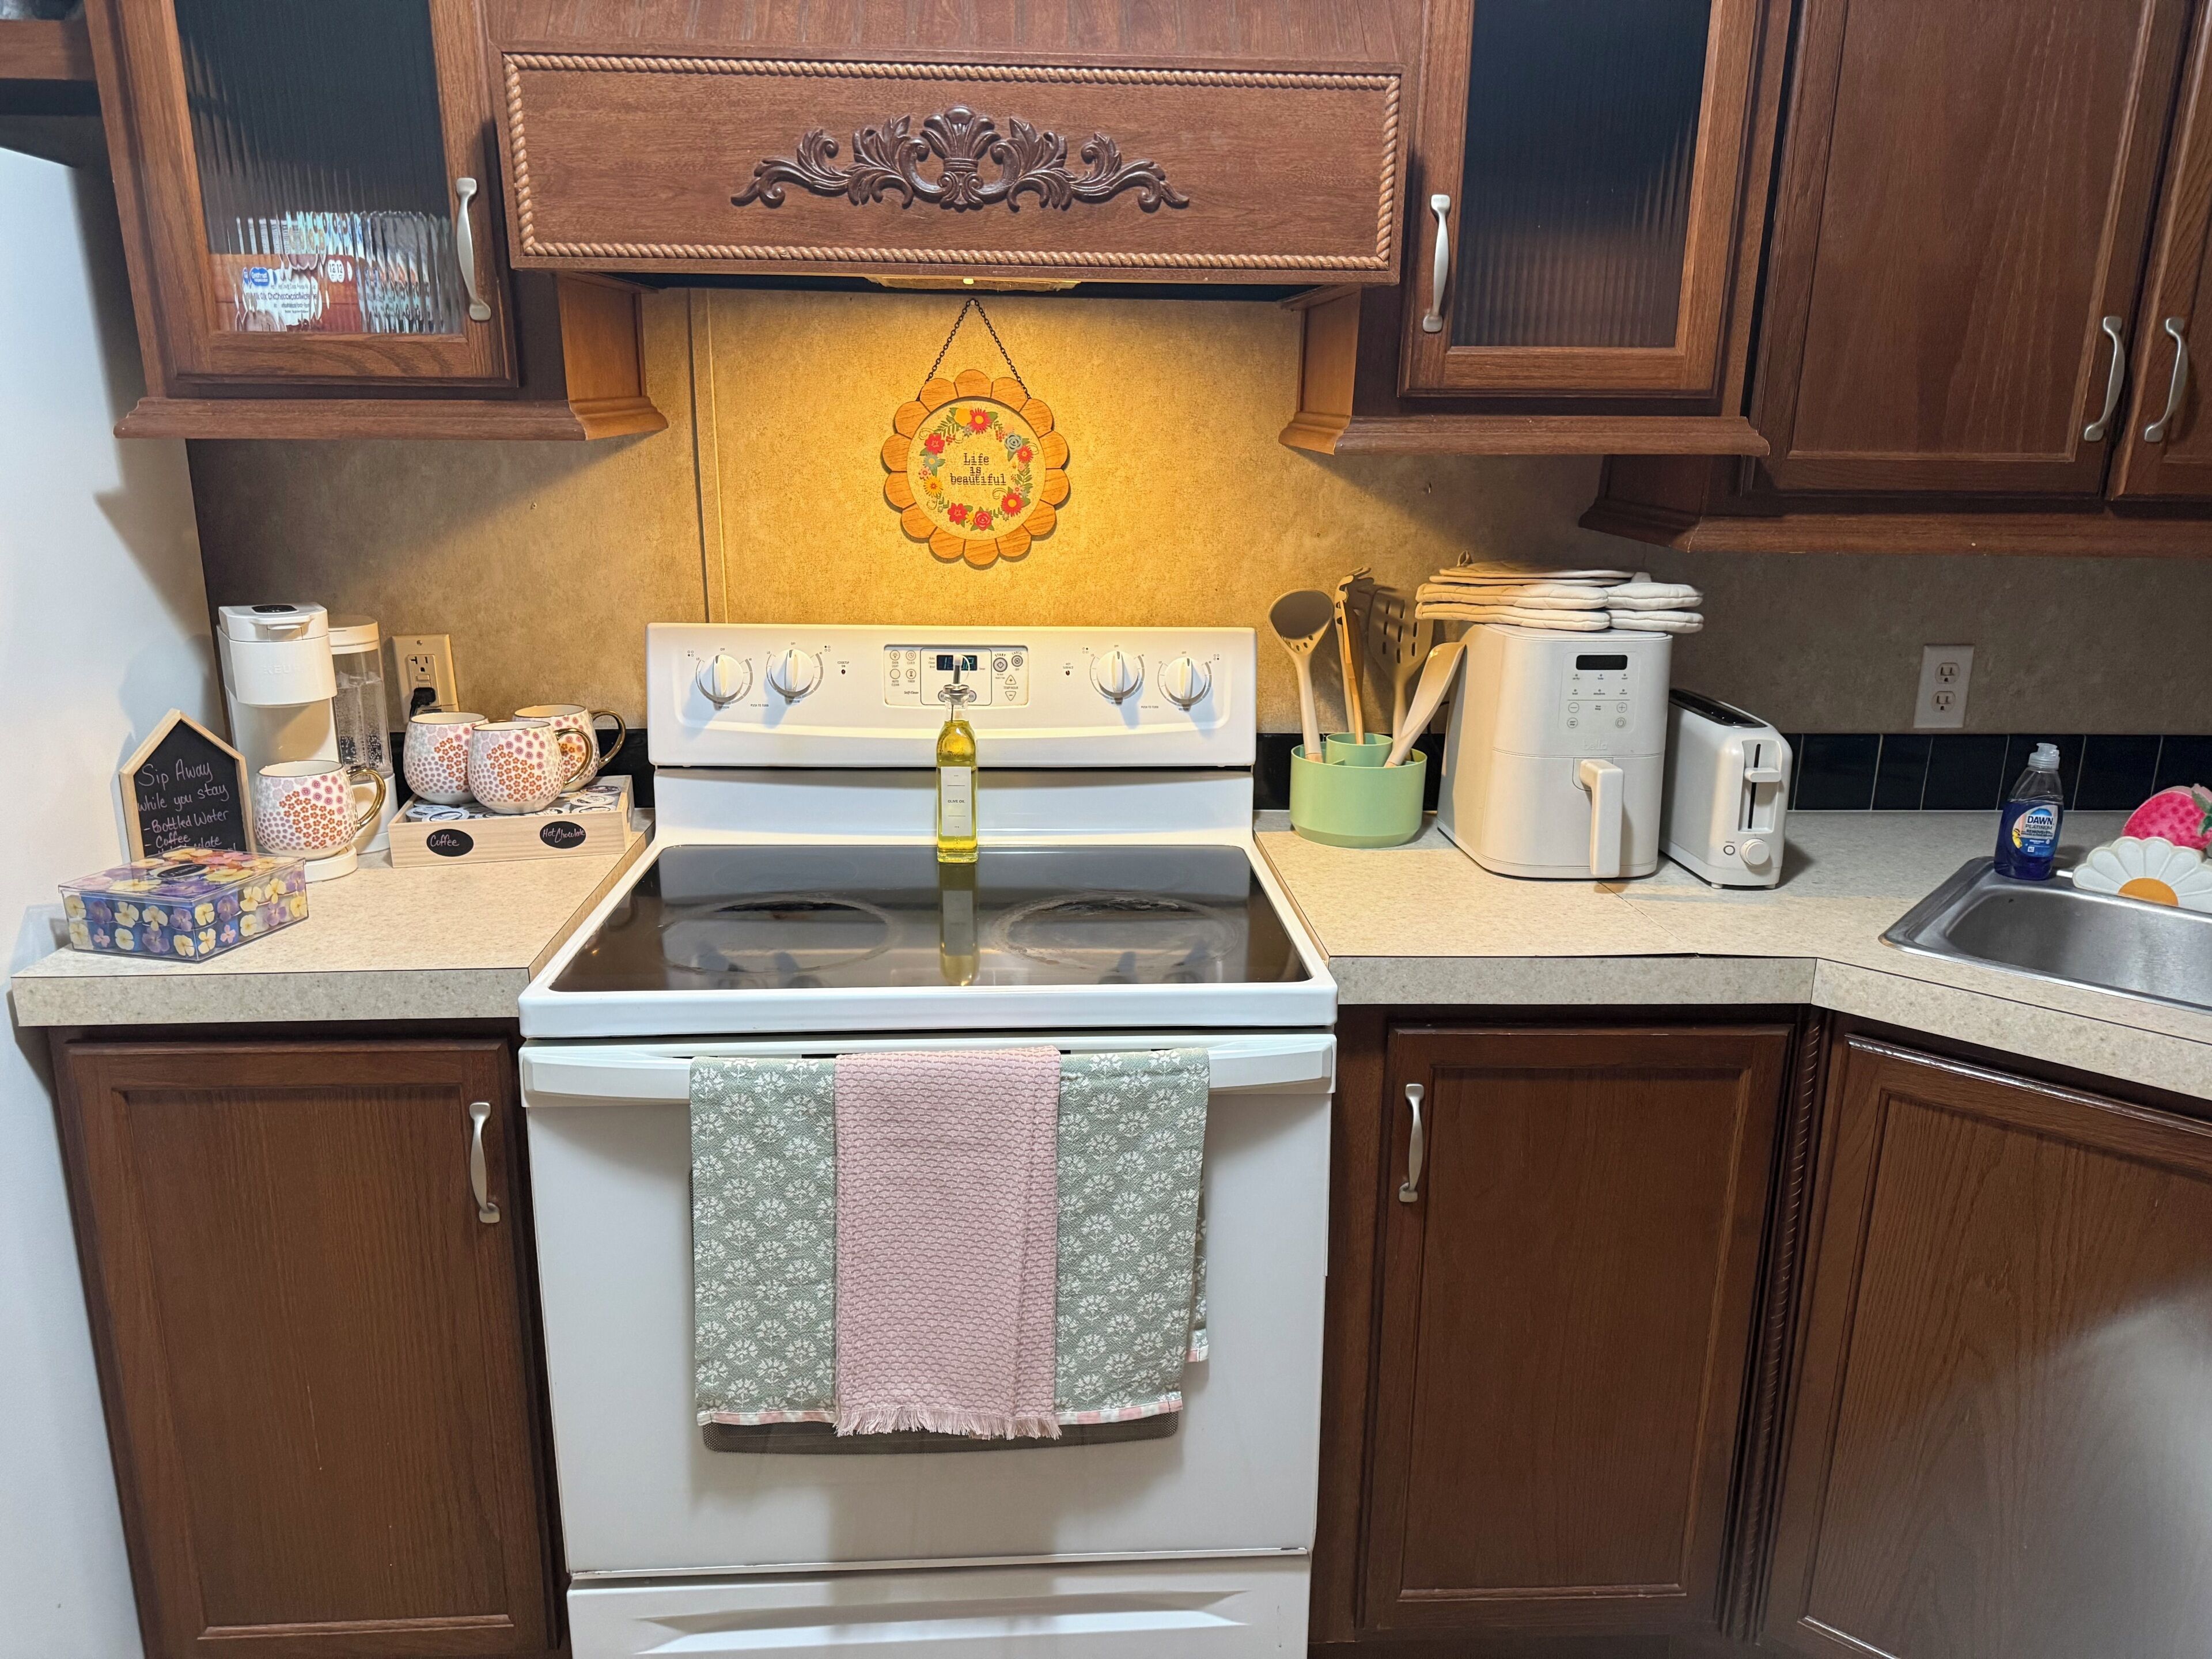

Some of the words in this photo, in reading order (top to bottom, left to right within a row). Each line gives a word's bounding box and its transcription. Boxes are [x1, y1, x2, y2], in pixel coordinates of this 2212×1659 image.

[963, 453, 989, 463] Life
[950, 473, 1006, 484] beautiful
[138, 764, 169, 791] Sip
[175, 759, 213, 783] Away
[138, 793, 167, 812] while
[173, 794, 193, 812] you
[197, 783, 229, 802] stay
[151, 815, 192, 834] Bottled
[194, 808, 229, 827] Water
[2027, 816, 2053, 825] DAWN
[156, 831, 191, 849] Coffee
[430, 834, 460, 847] Coffee
[543, 827, 556, 838] Hot
[555, 828, 586, 843] Chocolate
